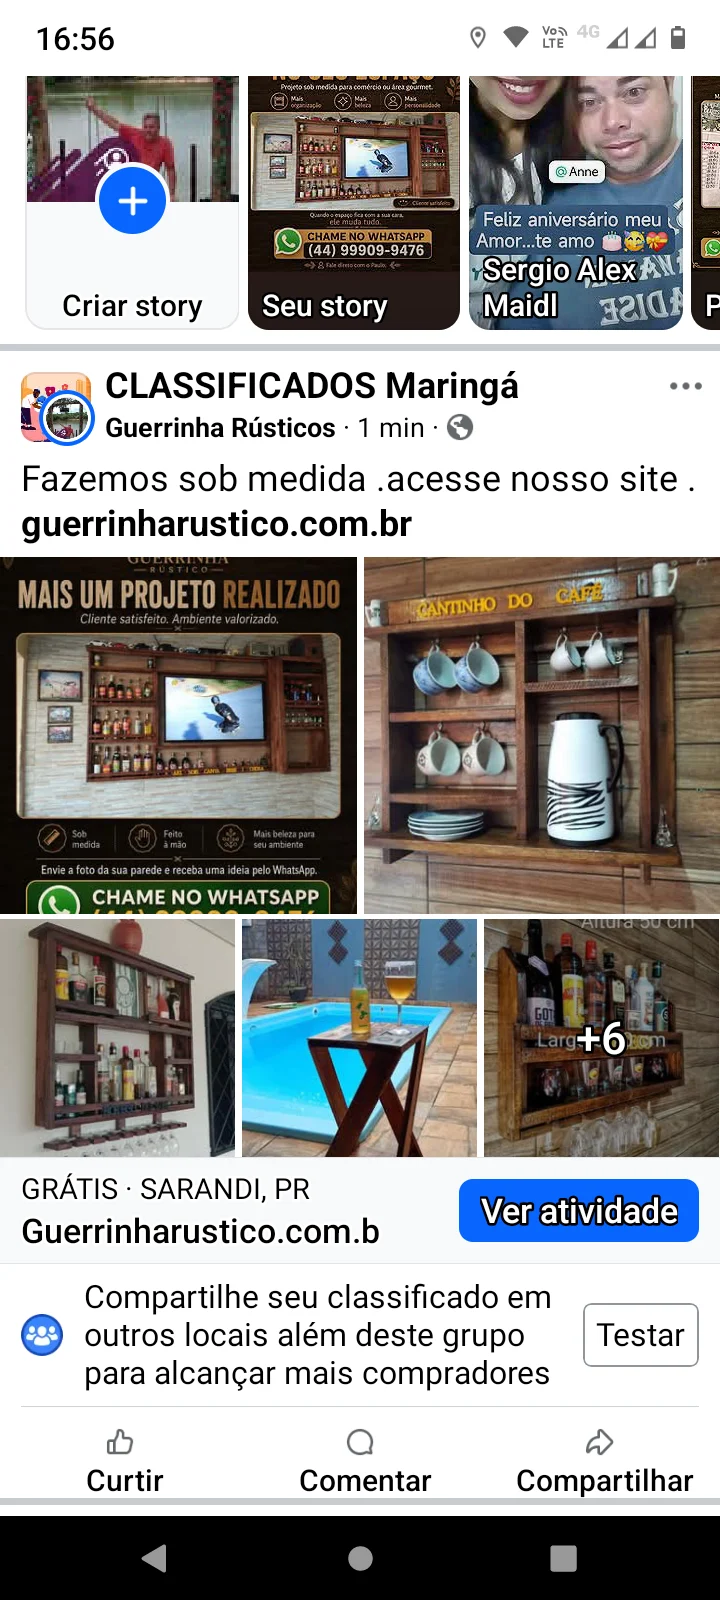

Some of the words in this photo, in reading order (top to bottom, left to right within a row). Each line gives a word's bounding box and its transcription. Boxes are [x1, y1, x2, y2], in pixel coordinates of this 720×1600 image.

[38, 27, 114, 50] 16:56
[577, 25, 599, 38] 4G
[543, 38, 563, 48] LTE
[280, 83, 303, 92] Projeto
[303, 83, 315, 91] sob
[315, 83, 338, 91] medida
[338, 84, 353, 92] para
[353, 83, 382, 91] comércio
[391, 83, 405, 91] área
[406, 82, 433, 91] gourmet.
[308, 232, 346, 241] CHAME
[349, 232, 365, 241] NO
[368, 232, 424, 241] WHATSAPP
[309, 244, 335, 257] (44)
[341, 244, 424, 256] 99909-9476
[484, 257, 569, 285] Sergio
[578, 257, 635, 280] Alex
[64, 294, 127, 316] Criar
[136, 296, 202, 322] story
[263, 294, 311, 316] Seu
[321, 296, 387, 322] story
[485, 294, 556, 316] Maidl
[107, 372, 375, 398] CLASSIFICADOS
[387, 371, 518, 405] Maringá
[106, 417, 223, 437] Guerrinha
[233, 417, 335, 437] Rústicos
[359, 418, 367, 437] 1
[381, 418, 423, 437] min
[24, 465, 167, 491] Fazemos
[180, 464, 237, 491] sob
[249, 464, 364, 491] medida
[379, 472, 500, 491] .acesse
[512, 472, 608, 491] nosso
[621, 465, 677, 491] site
[22, 509, 412, 543] guerrinharustico.com.br
[149, 565, 208, 574] RÚSTICO
[19, 580, 72, 608] MAIS
[81, 580, 113, 608] UM
[121, 580, 215, 609] PROJETO
[224, 580, 339, 608] REALIZADO
[417, 597, 497, 618] CANTINHO
[508, 593, 533, 609] DO
[81, 614, 116, 624] Cliente
[120, 613, 168, 624] satisfeito.
[172, 614, 221, 624] Ambiente
[225, 613, 278, 624] valorizado.
[71, 829, 88, 839] Sob
[72, 840, 101, 849] medida
[163, 829, 183, 839] Feito
[170, 840, 187, 849] mão
[252, 841, 268, 850] seu
[269, 840, 304, 849] ambiente
[253, 829, 271, 839] Mais
[273, 829, 296, 839] beleza
[298, 831, 315, 841] para
[42, 865, 65, 874] Envie
[76, 865, 95, 874] foto
[98, 865, 109, 874] da
[111, 867, 128, 875] sua
[131, 865, 162, 876] parede
[173, 865, 202, 874] receba
[205, 867, 226, 875] uma
[228, 865, 249, 874] ideia
[253, 865, 270, 876] pelo
[273, 865, 317, 876] WhatsApp.
[93, 890, 165, 905] CHAME
[172, 890, 201, 905] NO
[208, 890, 319, 904] WHATSAPP
[577, 1021, 626, 1055] +6
[23, 1173, 117, 1199] GRÁTIS
[141, 1178, 265, 1203] SARANDI,
[276, 1178, 309, 1199] PR
[482, 1199, 532, 1223] Ver
[542, 1198, 677, 1223] atividade
[23, 1217, 379, 1243] Guerrinharustico.com.b
[85, 1284, 259, 1316] Compartilhe
[269, 1291, 316, 1308] seu
[328, 1284, 498, 1308] classificado
[508, 1291, 550, 1308] em
[85, 1325, 174, 1346] outros
[186, 1322, 267, 1346] locais
[279, 1322, 345, 1346] além
[356, 1322, 433, 1346] deste
[444, 1329, 524, 1352] grupo
[597, 1323, 684, 1346] Testar
[86, 1366, 145, 1391] para
[156, 1360, 275, 1391] alcançar
[286, 1361, 352, 1384] mais
[363, 1360, 549, 1391] compradores
[87, 1469, 163, 1491] Curtir
[300, 1469, 431, 1491] Comentar
[517, 1468, 693, 1498] Compartilhar
